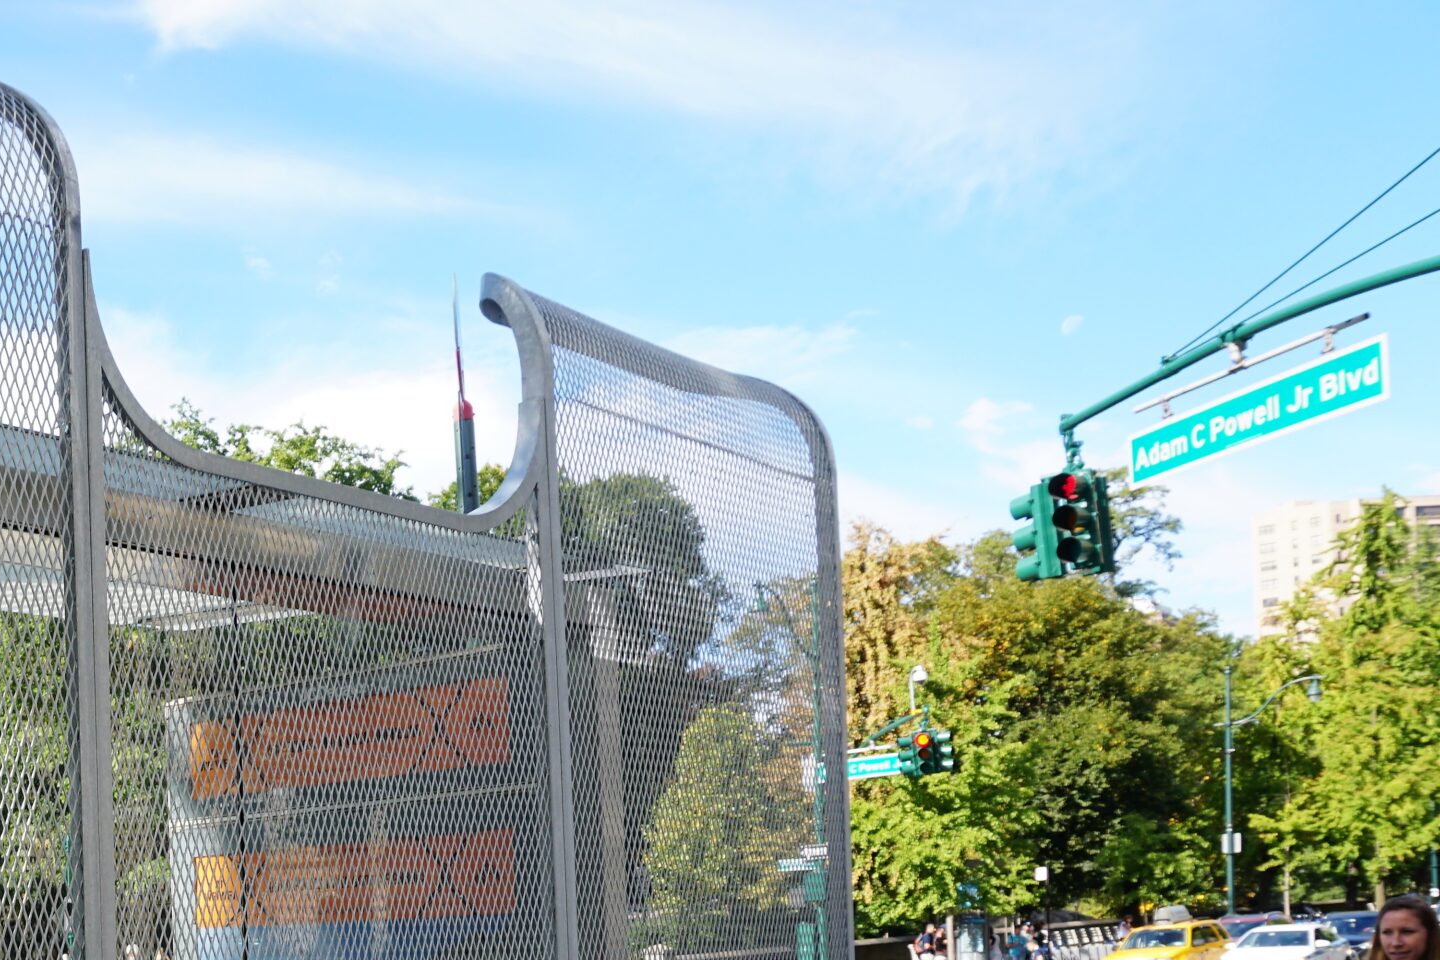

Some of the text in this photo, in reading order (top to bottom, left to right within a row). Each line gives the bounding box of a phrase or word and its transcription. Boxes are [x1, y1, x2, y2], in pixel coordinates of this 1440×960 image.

[1134, 358, 1380, 471] Adam C Powell Jr Blvd
[859, 760, 891, 773] Powell
